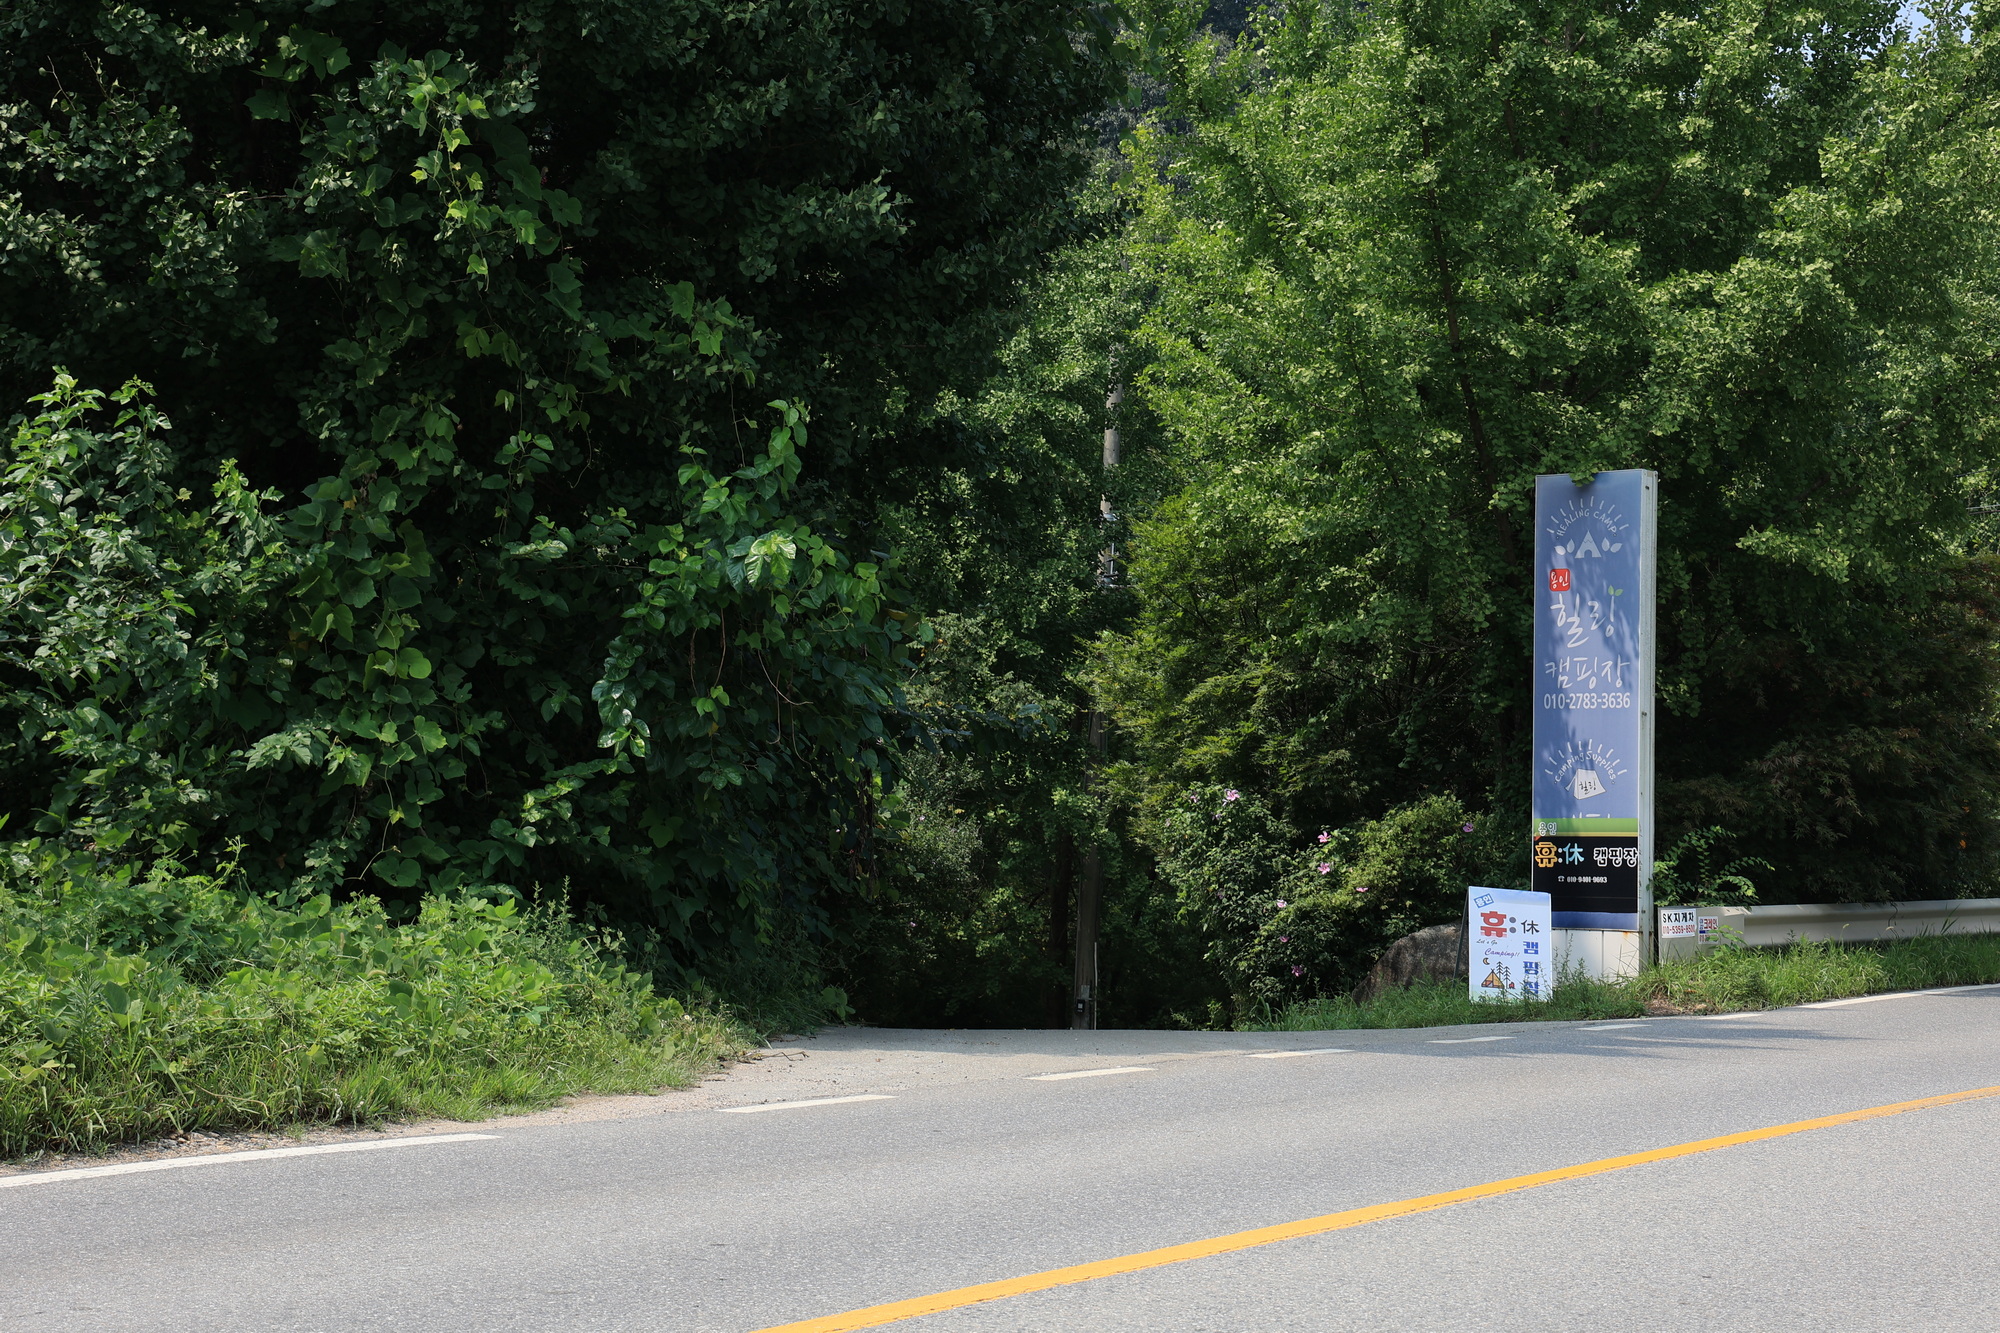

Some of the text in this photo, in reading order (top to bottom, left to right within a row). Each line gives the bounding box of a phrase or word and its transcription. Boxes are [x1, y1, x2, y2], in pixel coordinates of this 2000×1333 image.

[1556, 508, 1617, 537] HEALING CAMP
[1550, 571, 1569, 589] 용인
[1550, 593, 1617, 648] 힐링
[1545, 655, 1631, 689] 캠핑장
[1544, 692, 1631, 710] 010-2783-3636
[1585, 750, 1617, 781] Supplies
[1538, 821, 1558, 837] 용인
[1593, 847, 1638, 867] 캠핑장
